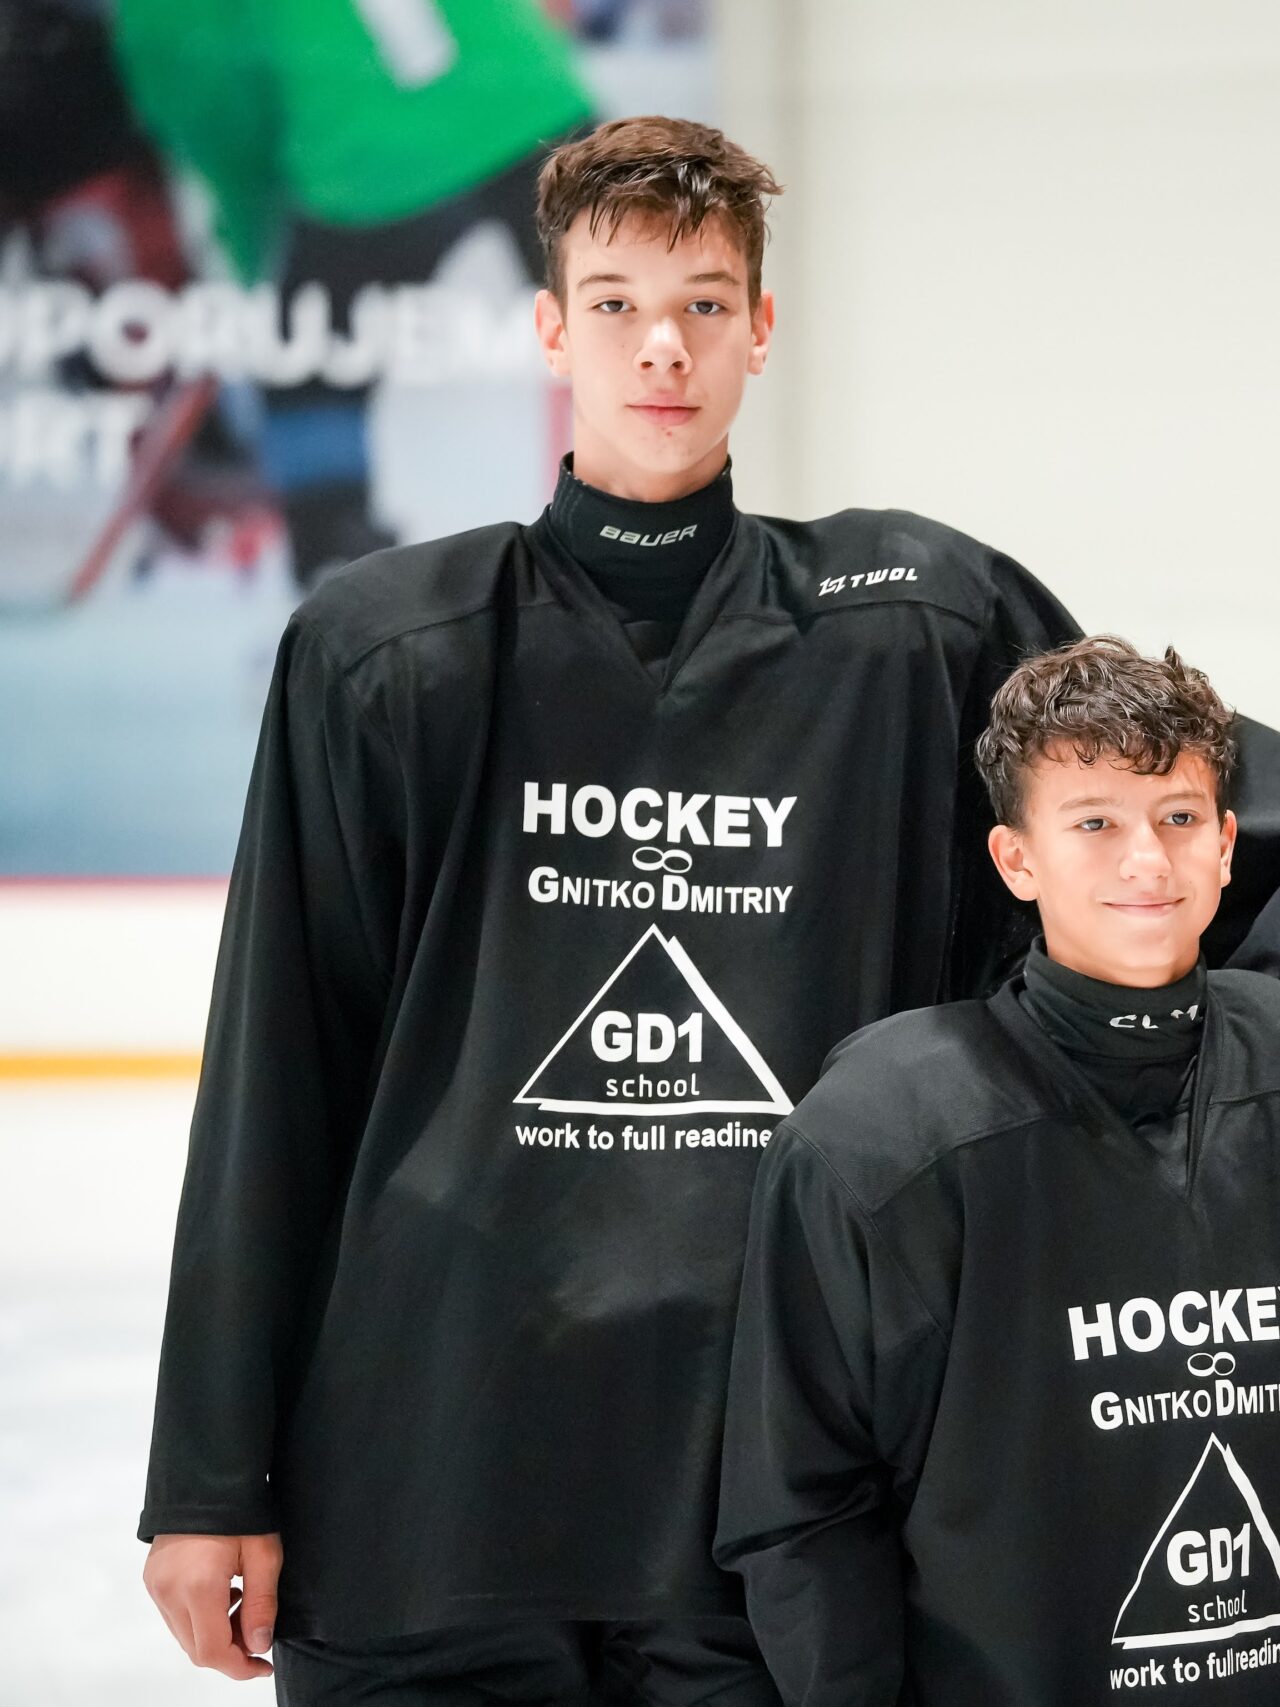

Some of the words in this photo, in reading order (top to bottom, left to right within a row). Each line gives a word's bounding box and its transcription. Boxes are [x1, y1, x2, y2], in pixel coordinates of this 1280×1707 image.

[599, 524, 698, 547] BAUER
[850, 567, 918, 588] TWOL
[522, 781, 798, 848] HOCKEY
[527, 865, 656, 910] GNITKO
[661, 874, 794, 915] DMITRIY
[590, 1010, 704, 1064] GD1
[606, 1072, 701, 1098] school
[514, 1122, 581, 1149] work
[587, 1124, 615, 1151] to
[621, 1124, 666, 1151] full
[1090, 1389, 1212, 1431] GNITKO
[1166, 1522, 1251, 1587] GD1
[1187, 1589, 1248, 1623] school
[1109, 1658, 1167, 1690] work
[1172, 1656, 1201, 1684] to
[1206, 1647, 1235, 1680] full
